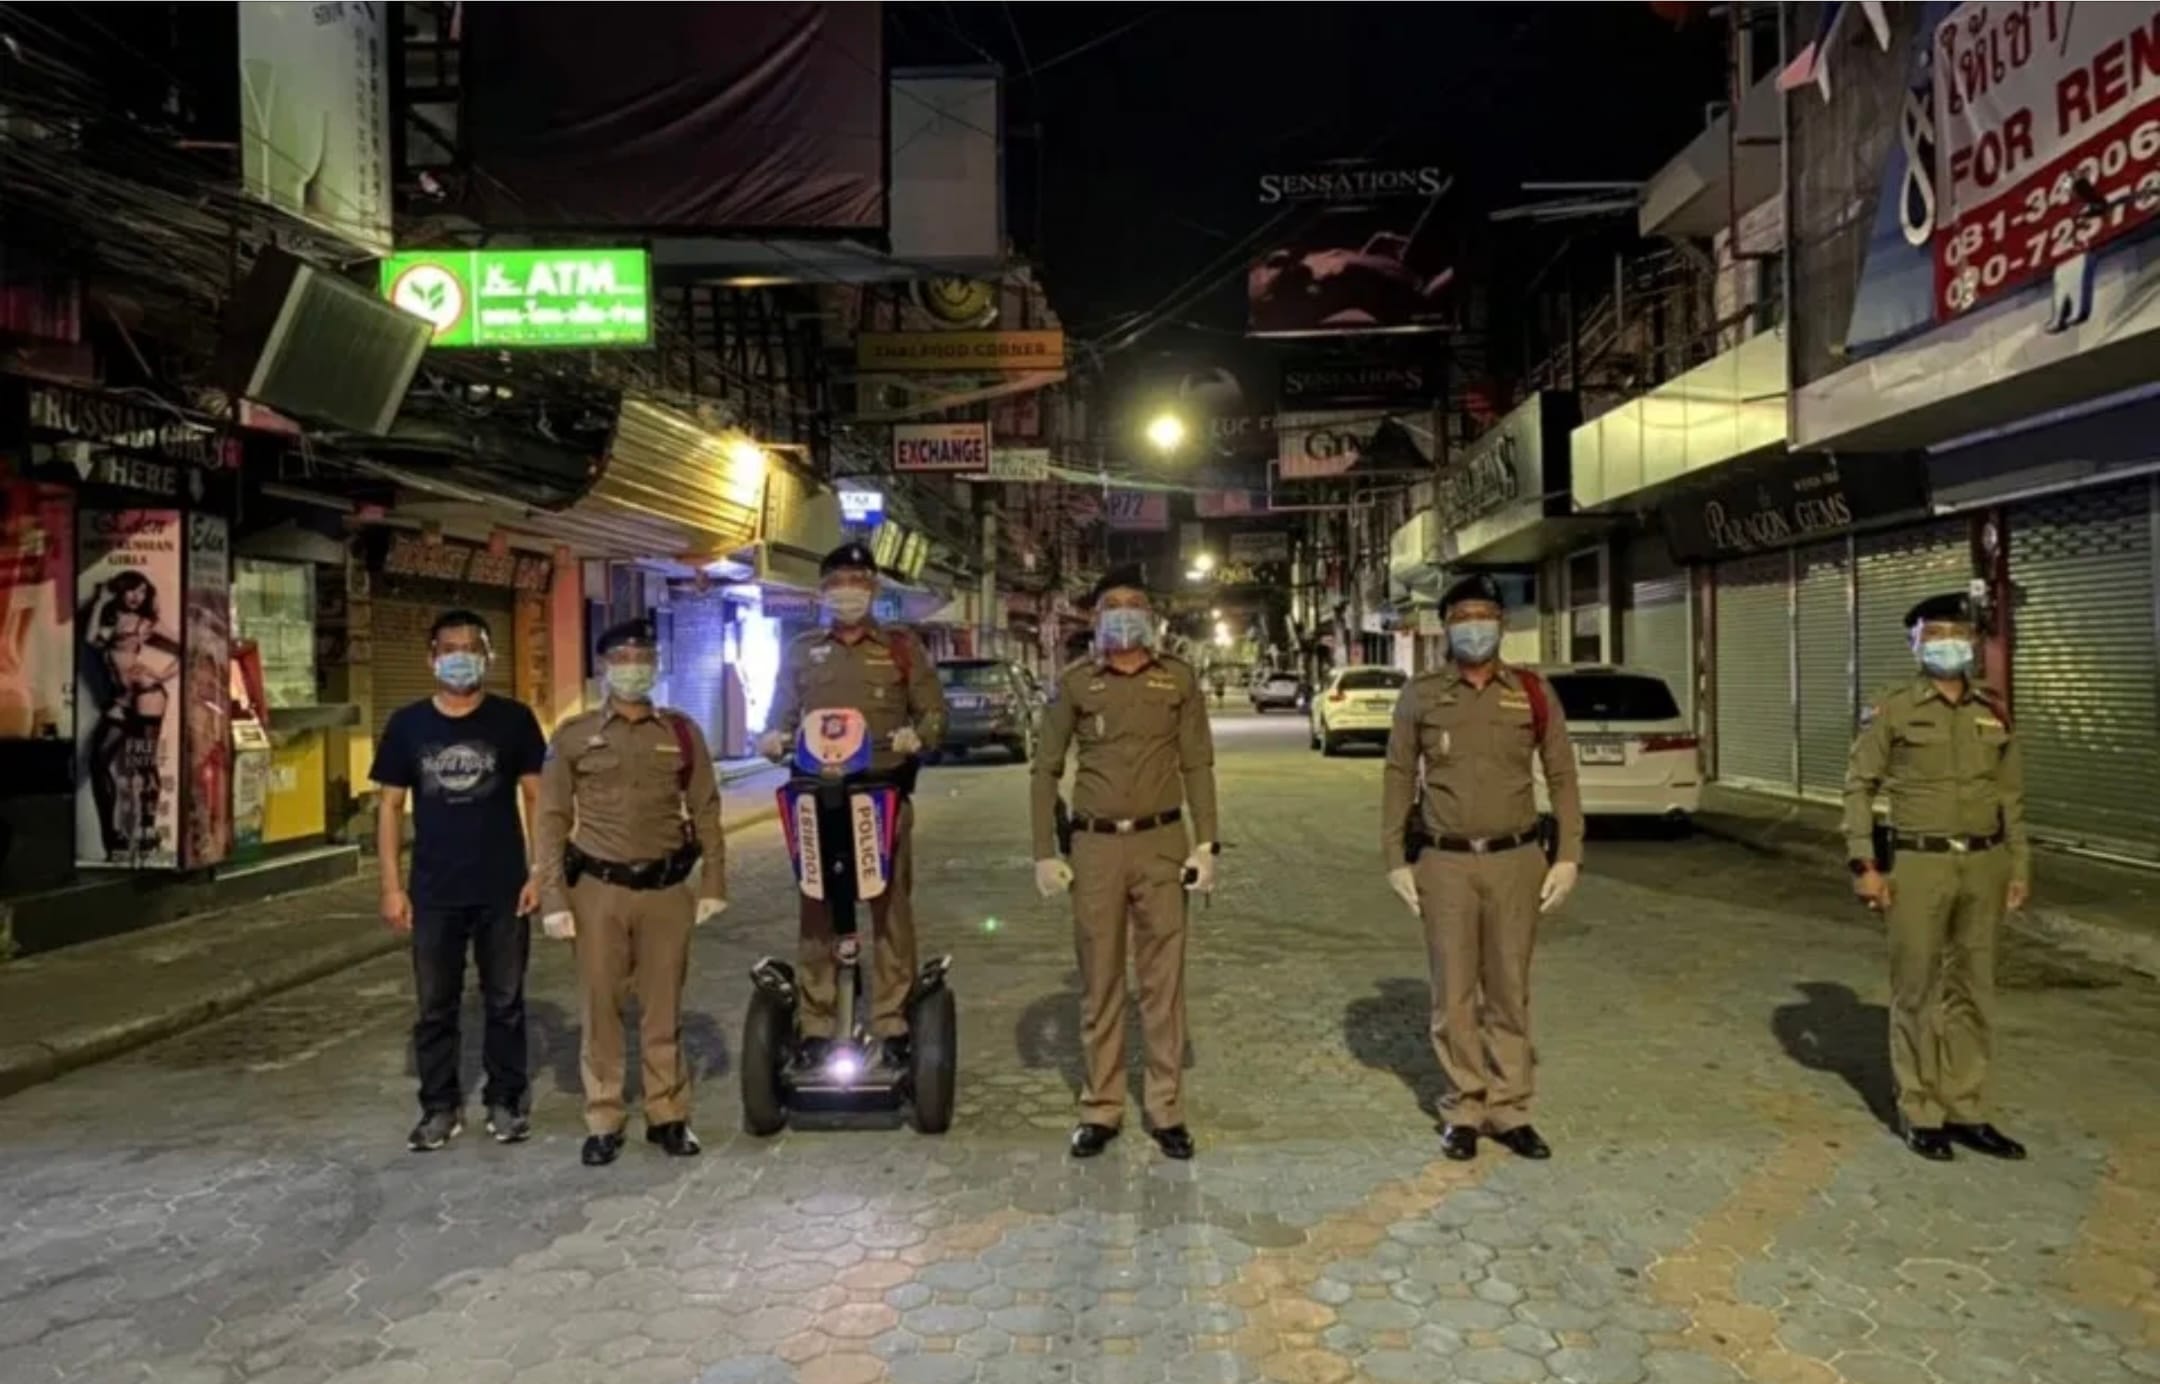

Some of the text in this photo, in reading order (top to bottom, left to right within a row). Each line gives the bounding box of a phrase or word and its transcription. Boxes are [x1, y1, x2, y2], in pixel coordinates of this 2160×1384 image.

[1950, 105, 2034, 188] FOR
[1258, 165, 1442, 205] SENSATIONS
[525, 260, 615, 296] ATM
[898, 438, 983, 465] EXCHANGE
[107, 454, 178, 496] HERE
[1795, 491, 1852, 533] GEMS
[800, 803, 819, 886] TOURIST
[857, 806, 878, 880] POLICE
